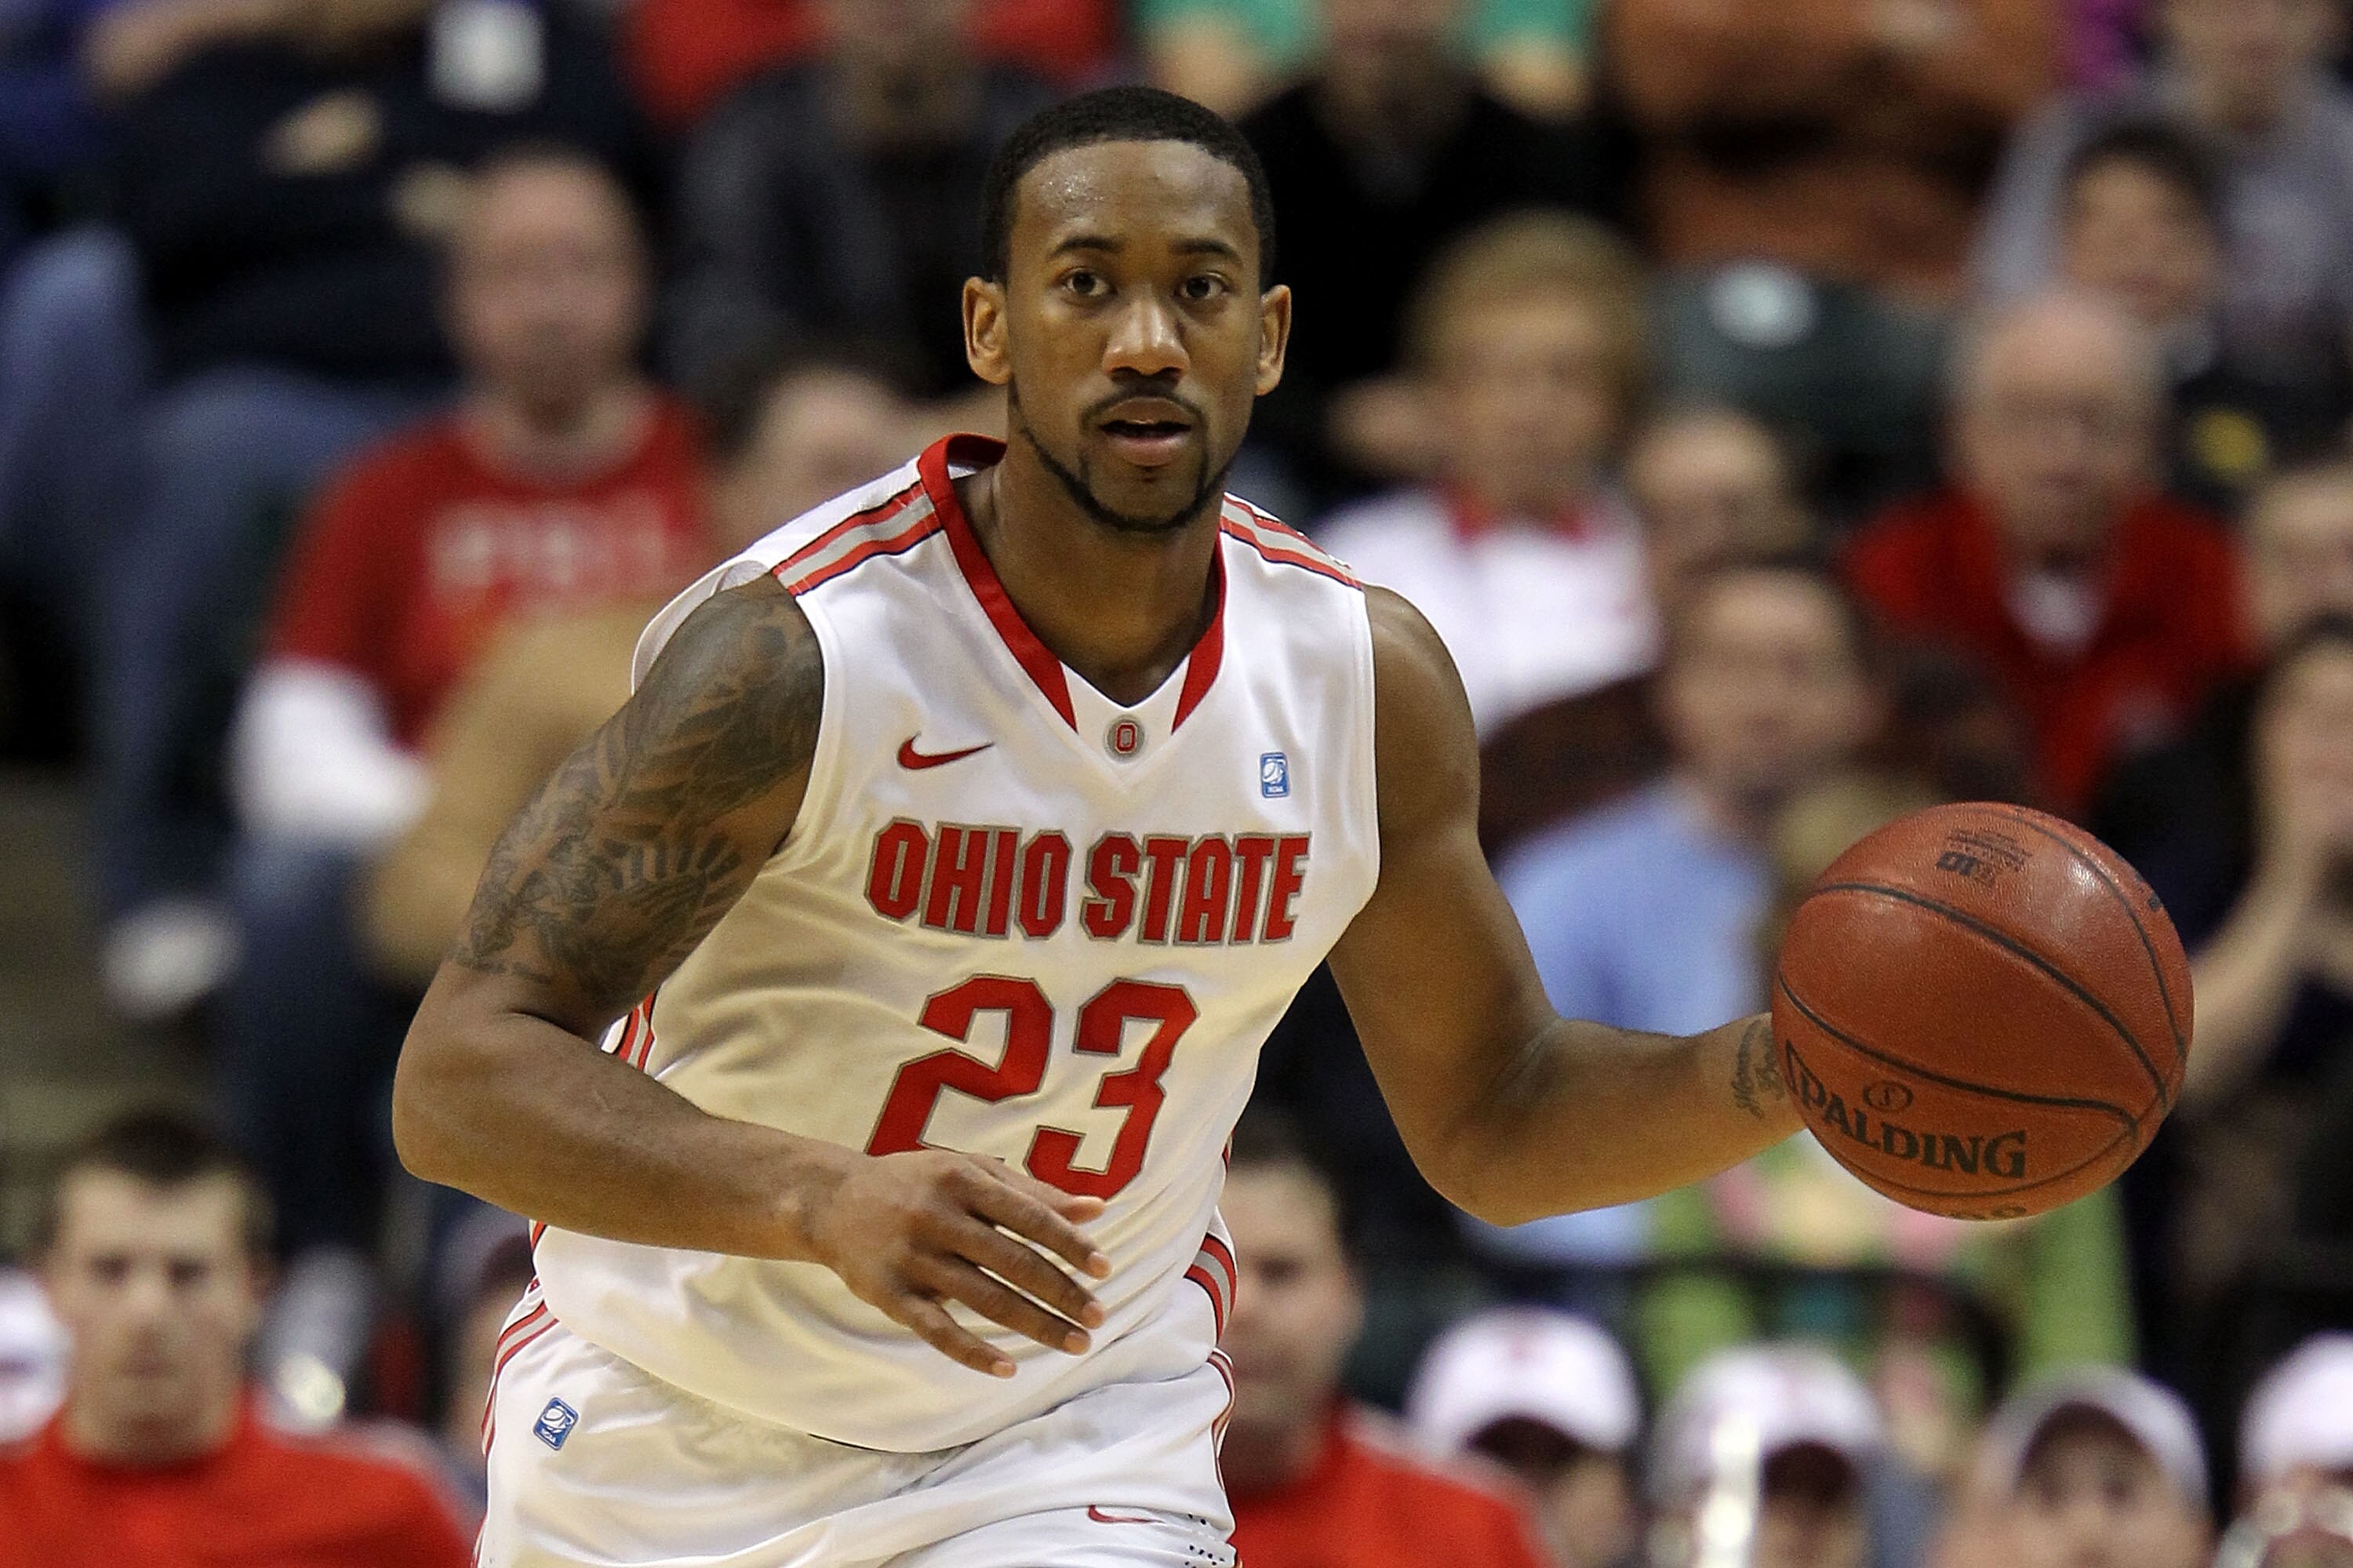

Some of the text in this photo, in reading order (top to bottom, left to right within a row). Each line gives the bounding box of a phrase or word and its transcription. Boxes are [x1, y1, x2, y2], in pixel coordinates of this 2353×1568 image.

[864, 816, 1312, 947] OHIO STATE
[864, 973, 1200, 1201] 23
